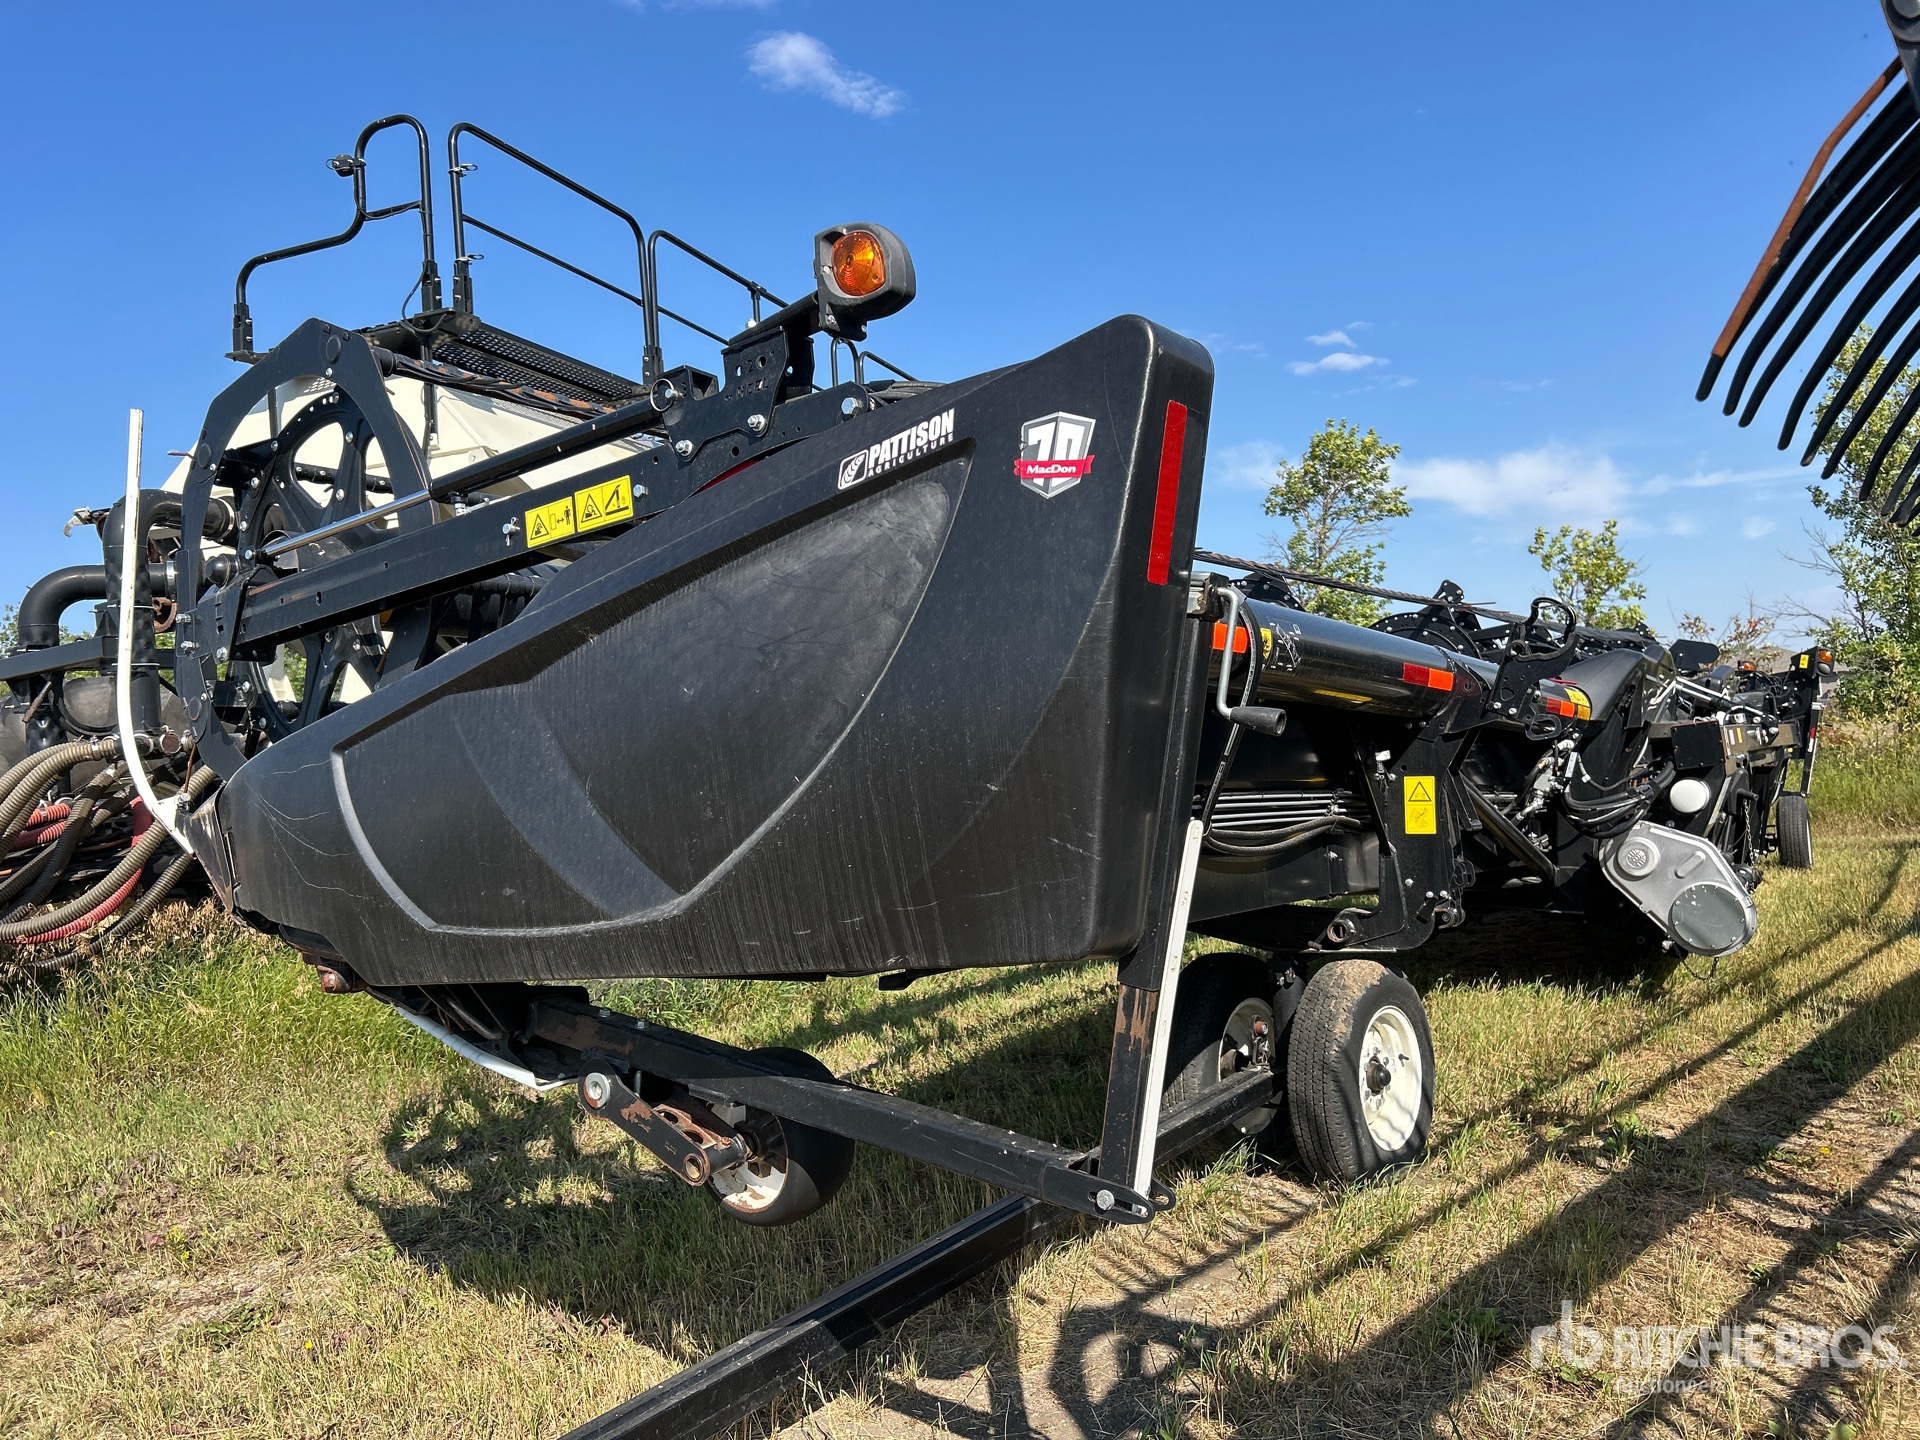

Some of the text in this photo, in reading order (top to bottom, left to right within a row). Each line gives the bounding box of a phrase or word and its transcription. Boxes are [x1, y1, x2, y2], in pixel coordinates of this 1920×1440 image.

[868, 407, 955, 469] PATTISON
[868, 432, 954, 478] AGRICULTURE
[1027, 421, 1085, 488] 70
[1026, 463, 1077, 475] MacDon
